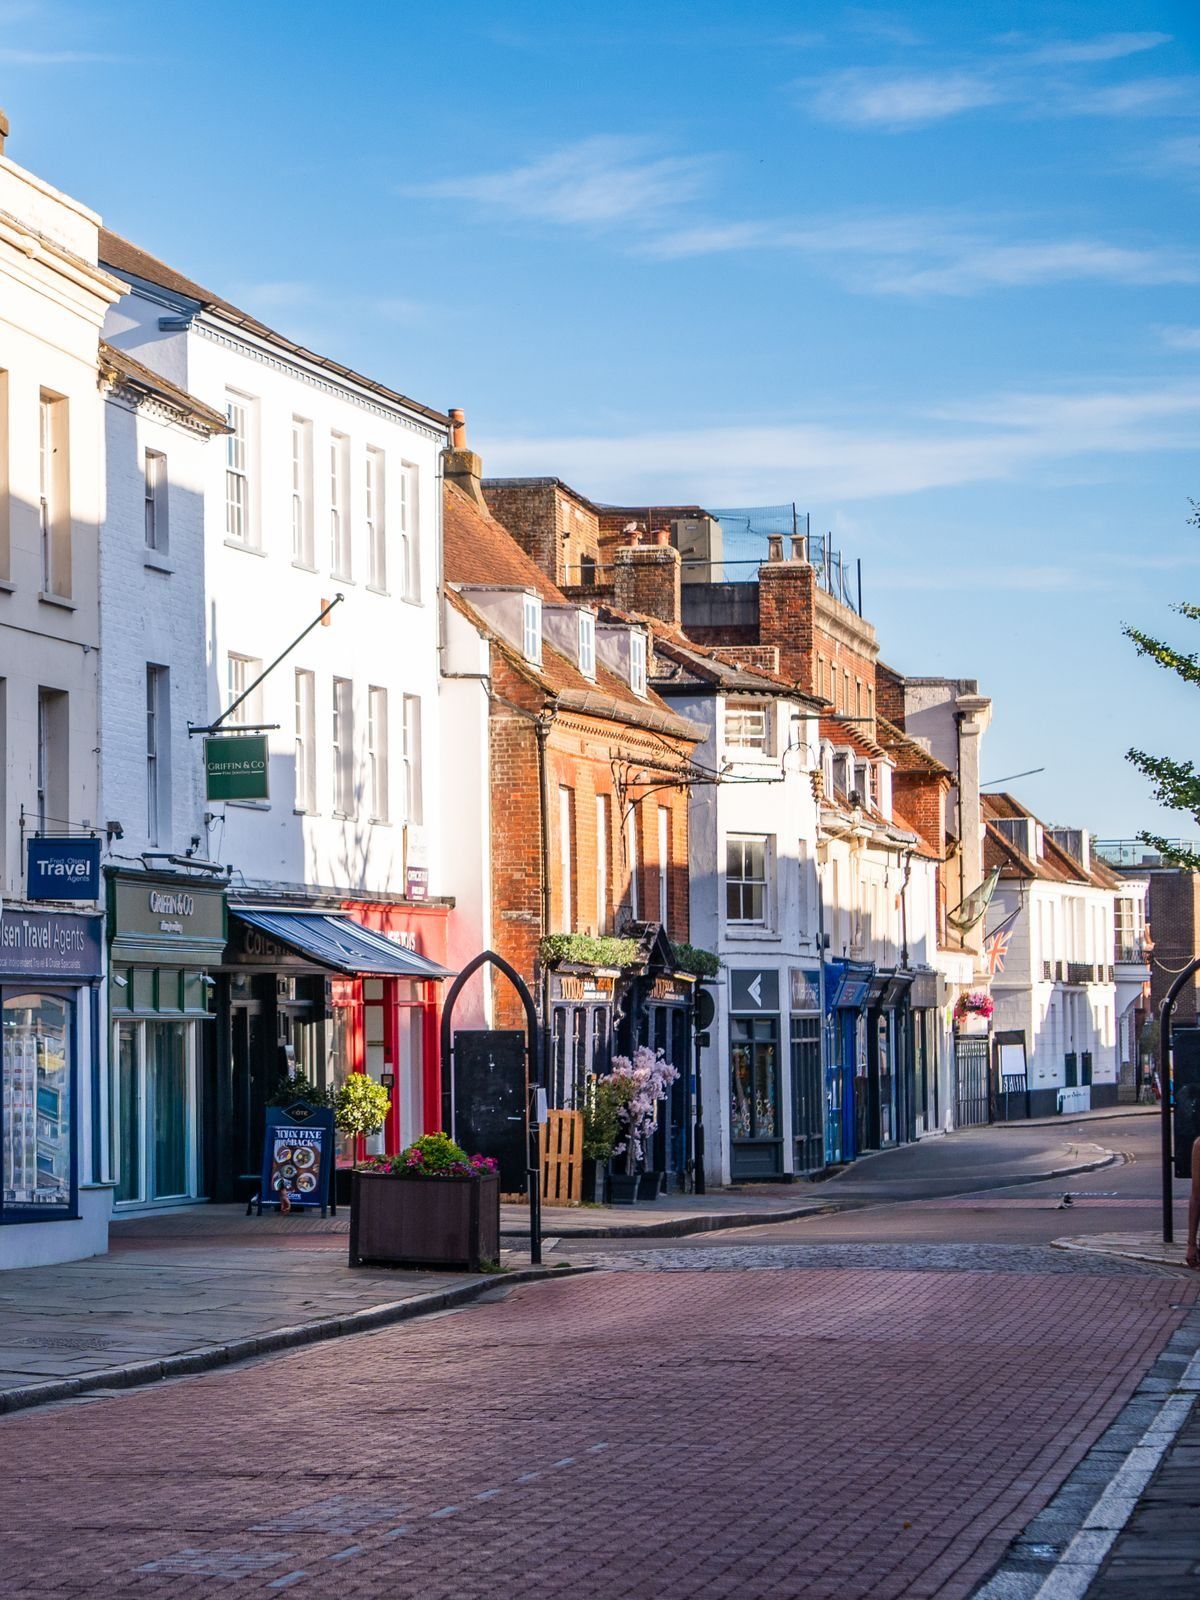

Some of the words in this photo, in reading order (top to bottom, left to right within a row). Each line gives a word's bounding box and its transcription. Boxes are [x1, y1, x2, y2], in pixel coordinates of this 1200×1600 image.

[207, 762, 242, 770] GRIFFIN
[243, 761, 250, 769] &
[37, 860, 91, 876] Travel
[67, 875, 90, 883] Agents
[22, 920, 51, 949] Travel
[53, 922, 85, 955] Agents
[299, 1130, 322, 1139] FIXE
[291, 1139, 314, 1147] BACK
